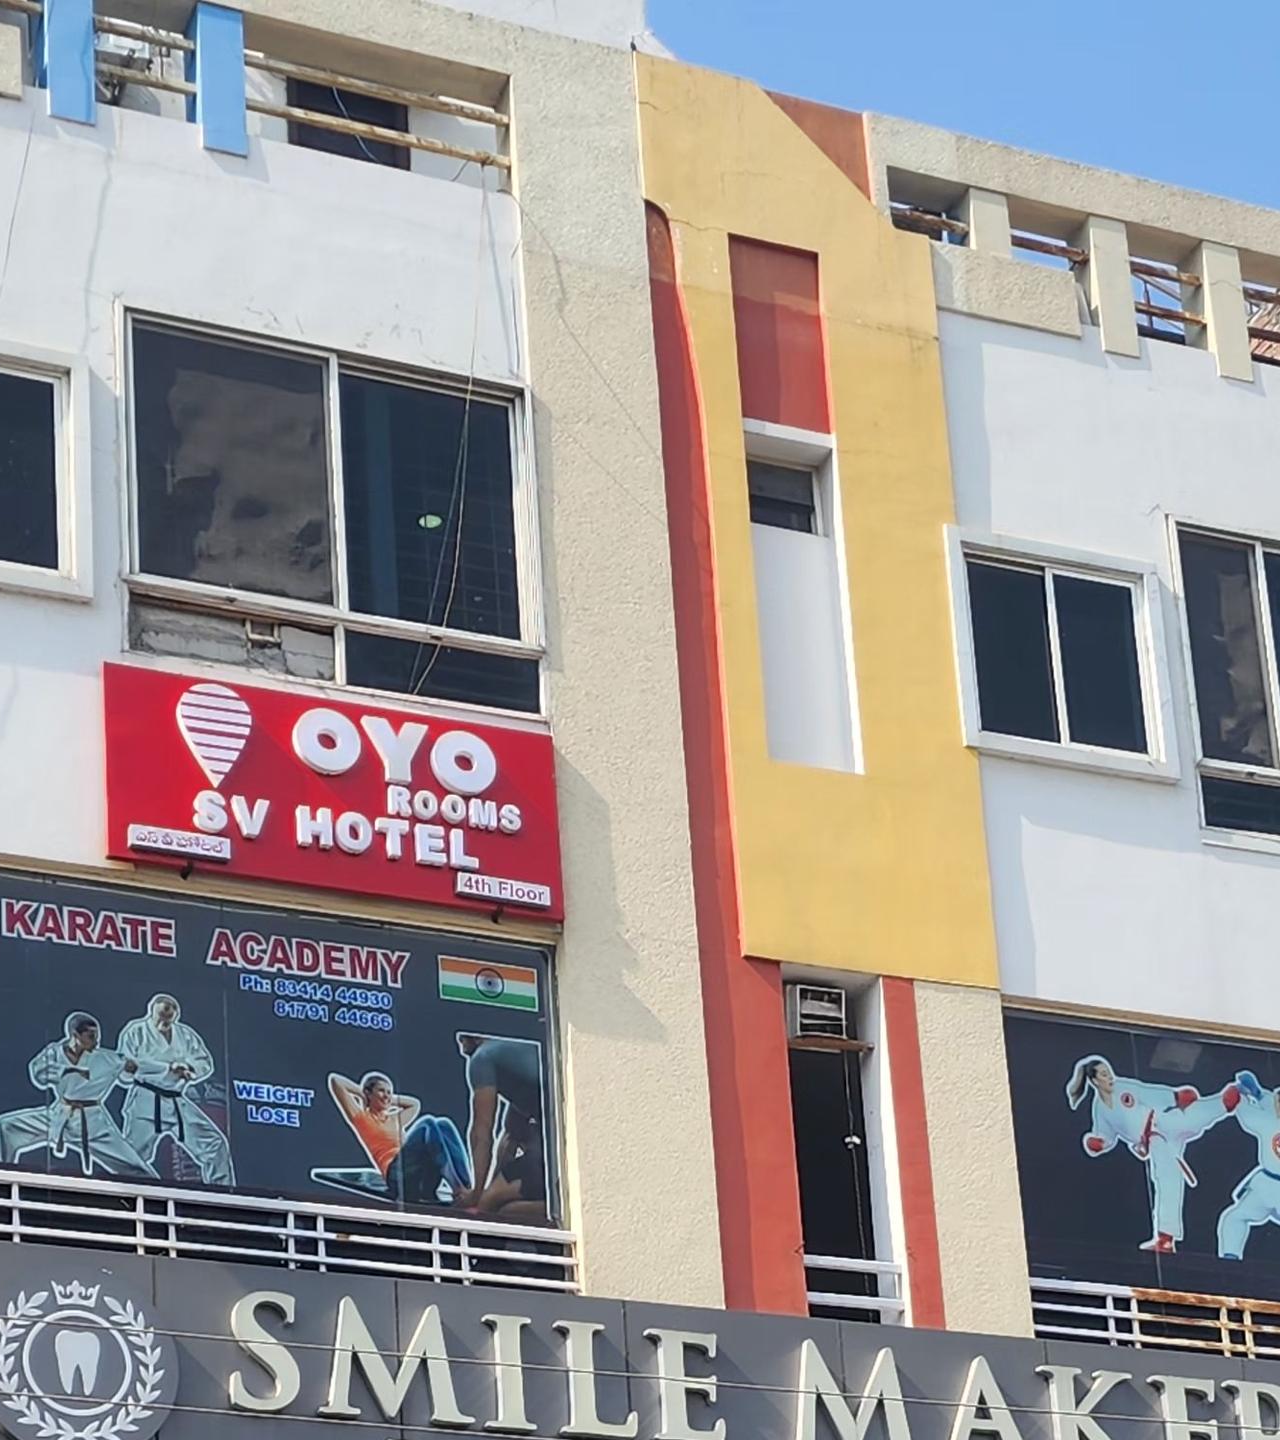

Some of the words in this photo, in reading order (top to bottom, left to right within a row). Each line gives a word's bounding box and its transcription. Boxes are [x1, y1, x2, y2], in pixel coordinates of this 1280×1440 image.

[292, 708, 496, 796] OYO
[387, 785, 521, 834] ROOMS
[192, 789, 270, 839] SV
[296, 805, 480, 871] HOTEL
[464, 877, 492, 895] 4th
[498, 882, 545, 904] Floor
[1, 898, 176, 958] KARATE
[206, 928, 411, 988] ACADEMY
[240, 974, 271, 994] Ph:
[274, 978, 333, 1001] 83414
[335, 987, 393, 1010] 44930
[274, 1000, 330, 1022] 81791
[335, 1007, 393, 1031] 44666
[233, 1079, 314, 1107] WEIGHT
[247, 1105, 300, 1127] LOSE
